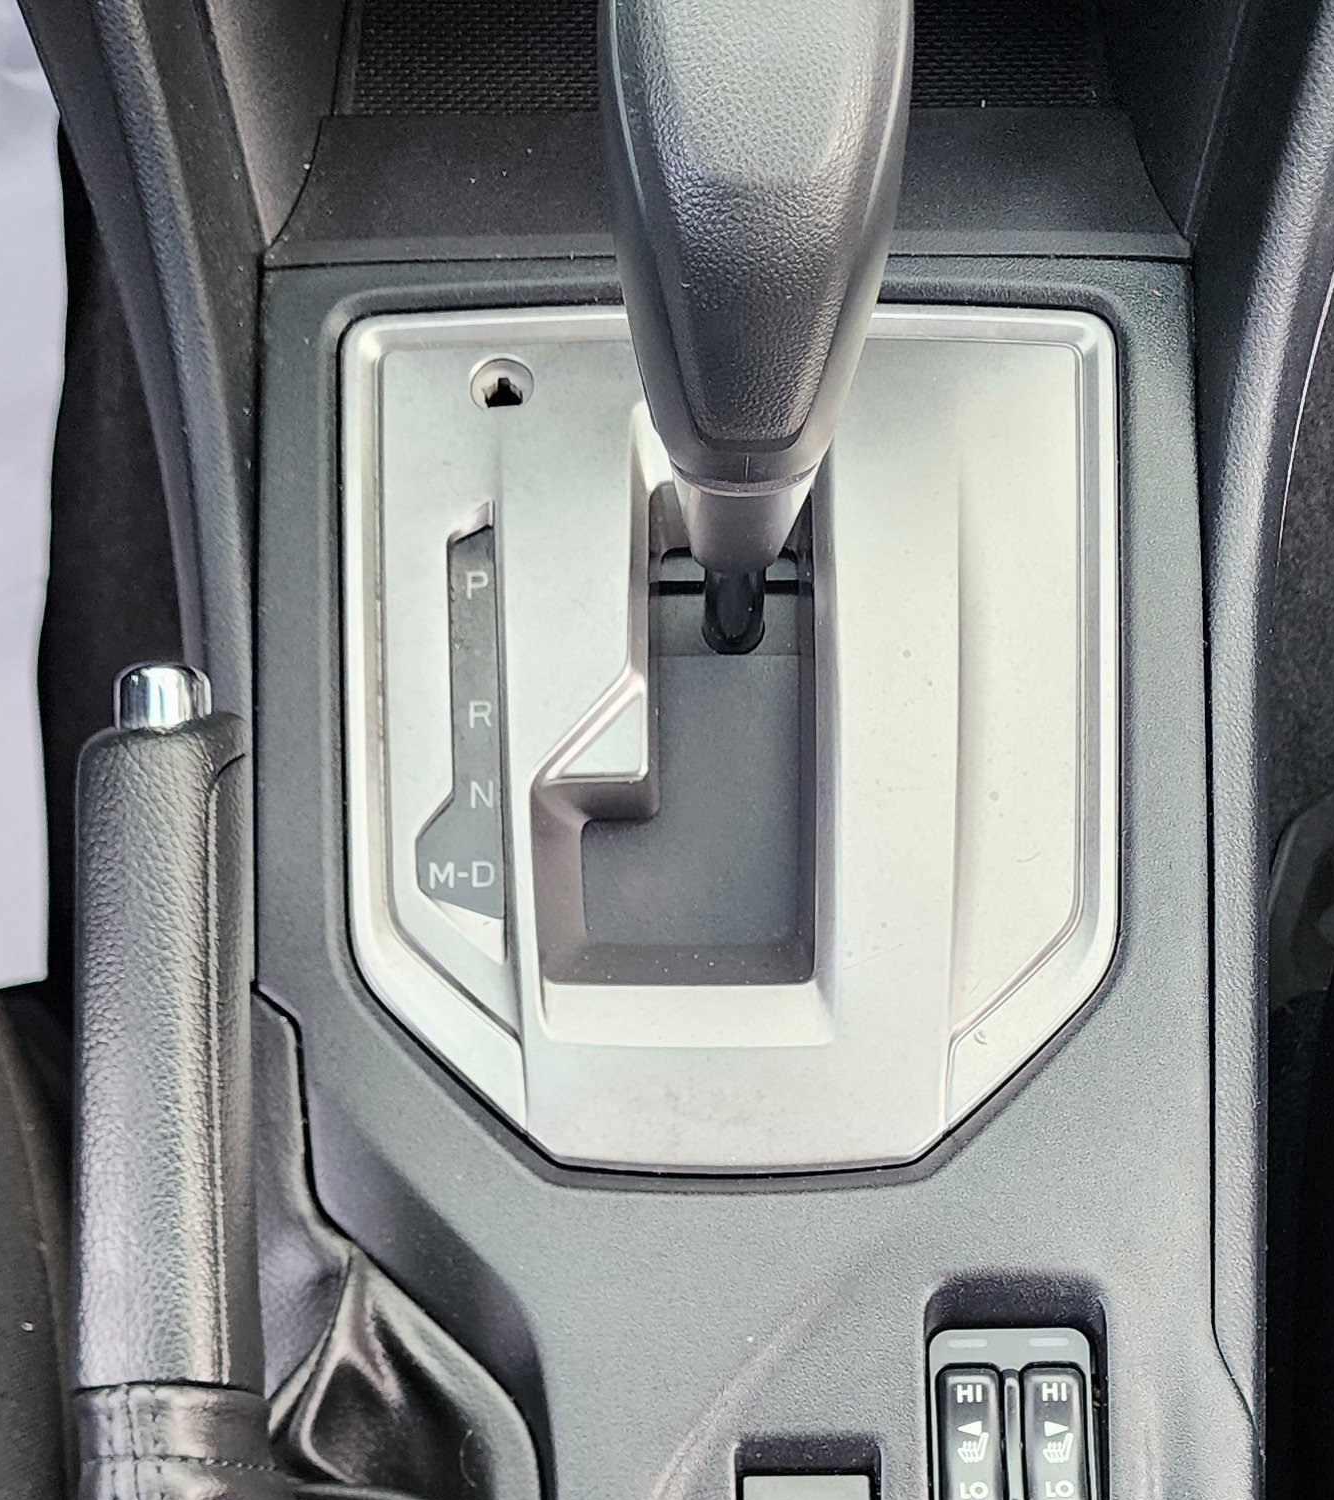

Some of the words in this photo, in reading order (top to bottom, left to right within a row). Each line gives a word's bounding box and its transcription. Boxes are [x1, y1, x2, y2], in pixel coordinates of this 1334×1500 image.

[467, 571, 489, 599] P
[469, 702, 492, 728] R
[471, 781, 493, 808] N
[429, 862, 495, 888] M-D
[957, 1385, 982, 1403] HI
[1042, 1383, 1067, 1401] HI
[960, 1482, 989, 1499] LO
[1046, 1481, 1074, 1497] LO
